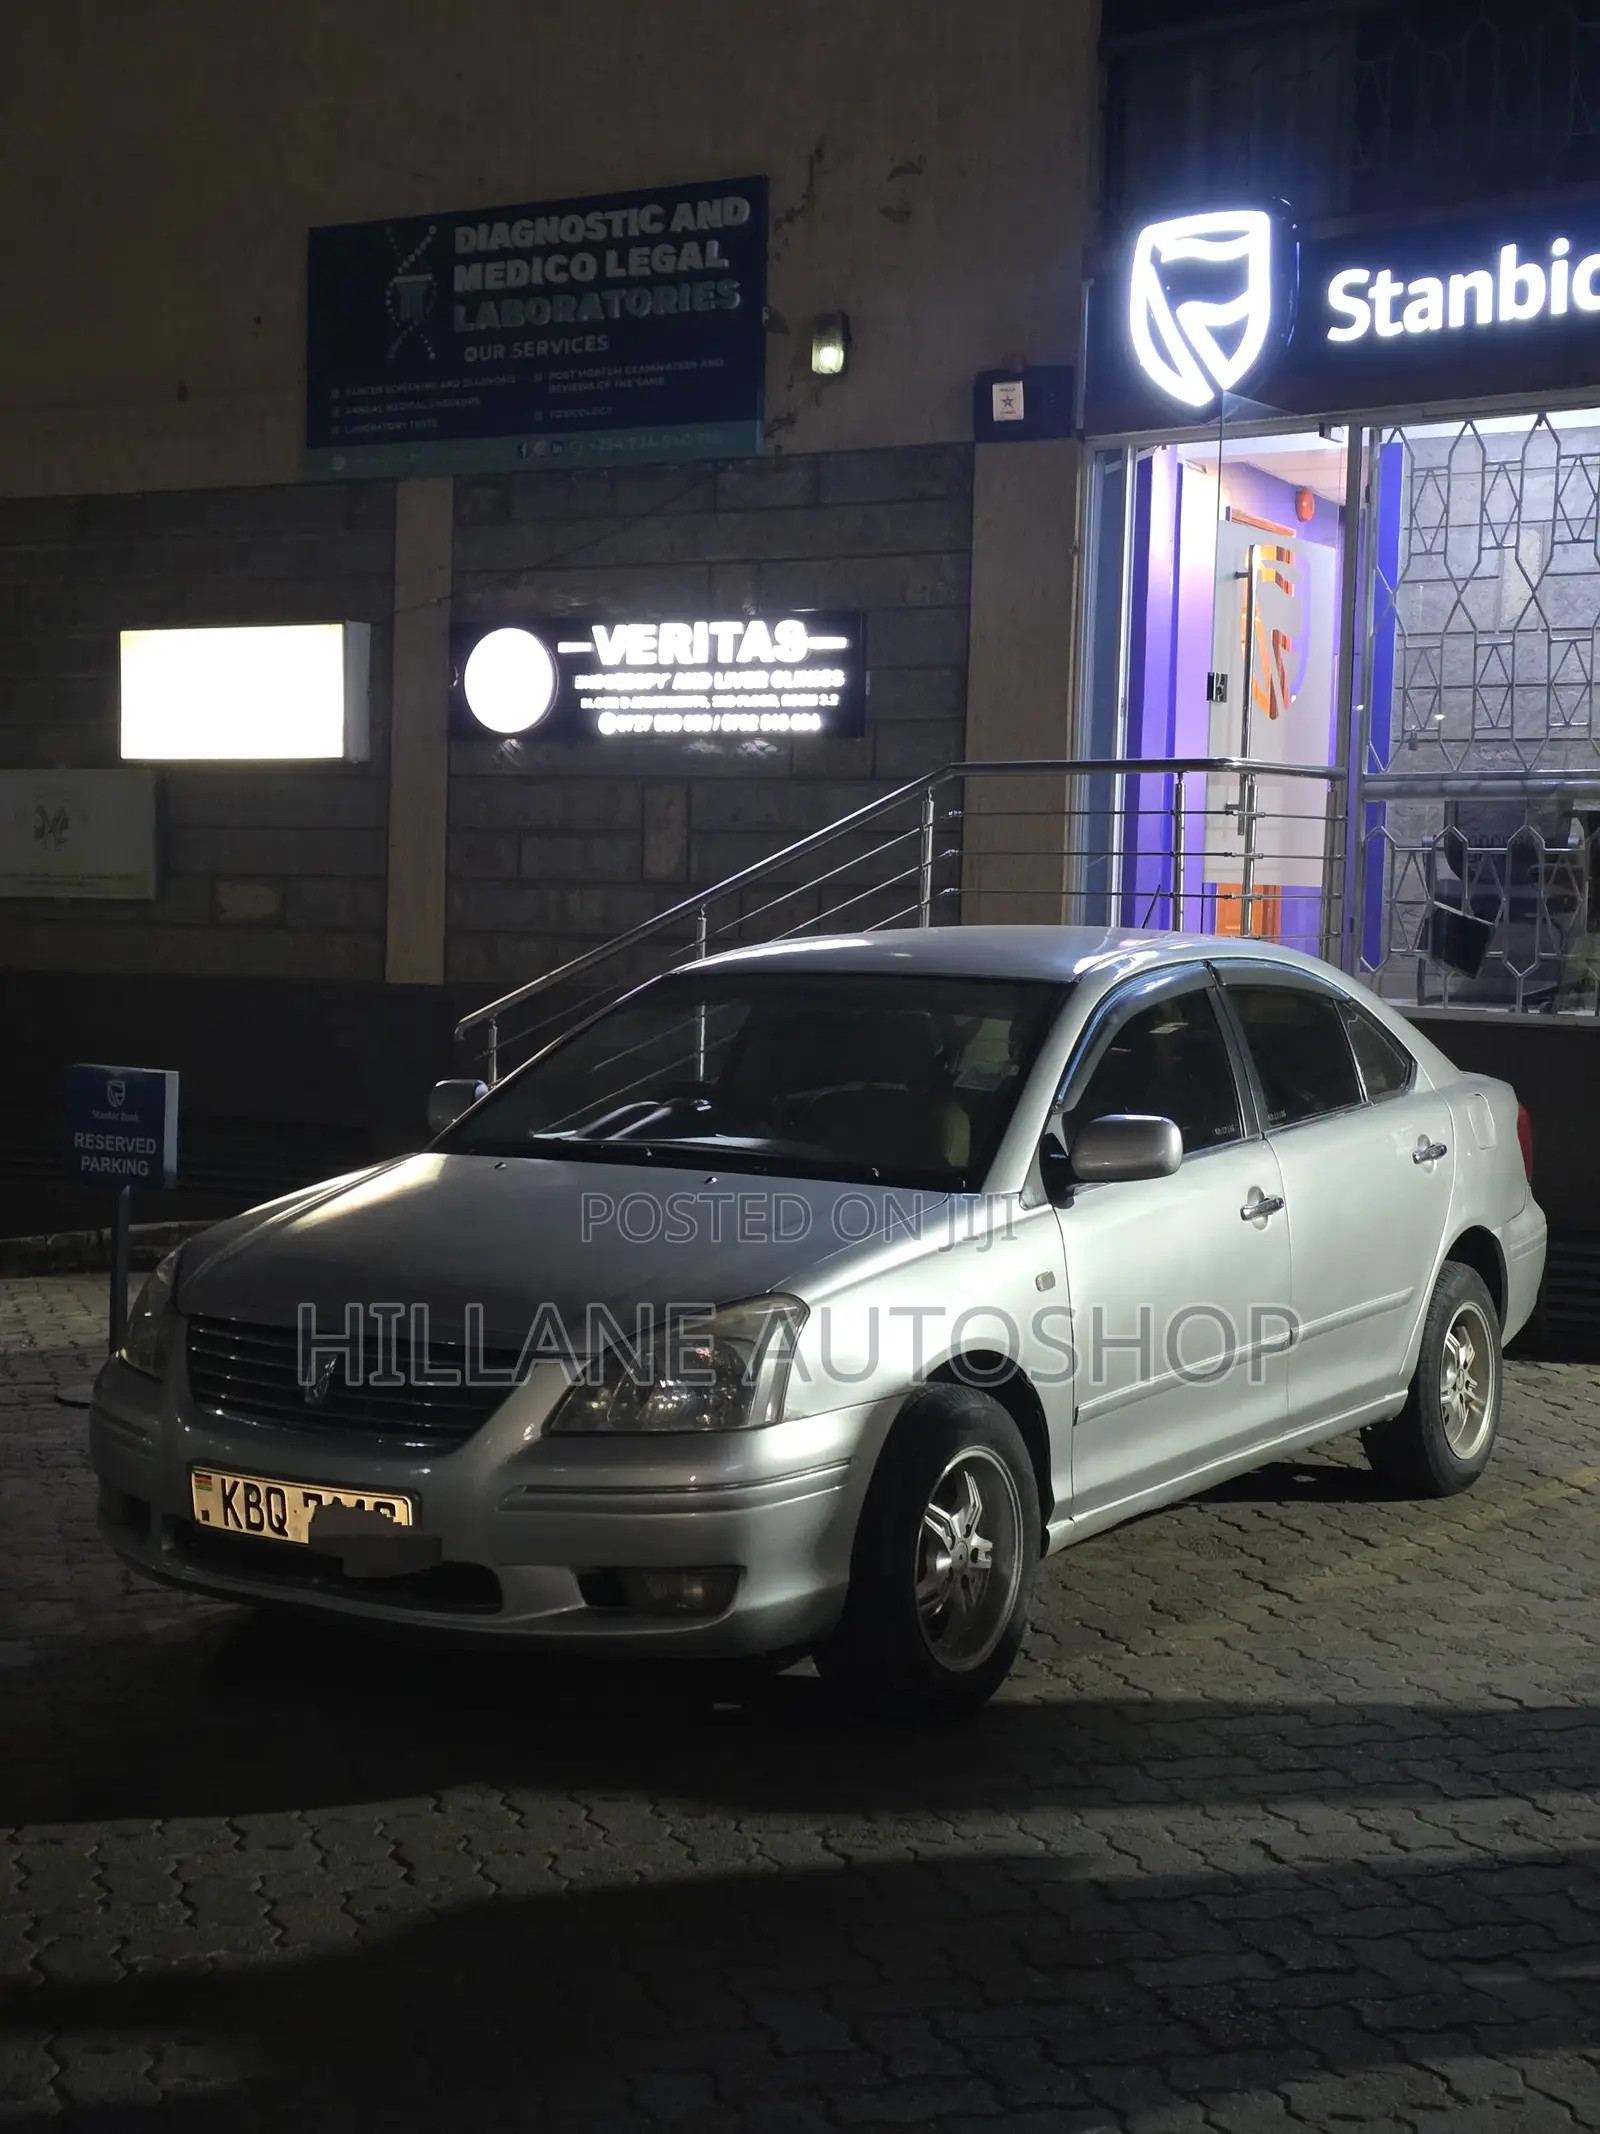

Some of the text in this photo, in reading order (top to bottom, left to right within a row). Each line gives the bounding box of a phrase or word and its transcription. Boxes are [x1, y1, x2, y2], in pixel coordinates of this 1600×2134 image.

[454, 196, 751, 255] DIAGNOSTIC AND
[453, 240, 729, 293] MEDICO LEGAL
[1327, 237, 1600, 342] Stanbic
[453, 278, 741, 333] LABORATORIES
[464, 334, 609, 363] OUR SERVICES
[701, 357, 724, 368] AND
[591, 619, 811, 666] VERITAS
[74, 1131, 157, 1155] RESERVED
[81, 1154, 149, 1177] PARKING
[220, 1477, 289, 1537] KBQ
